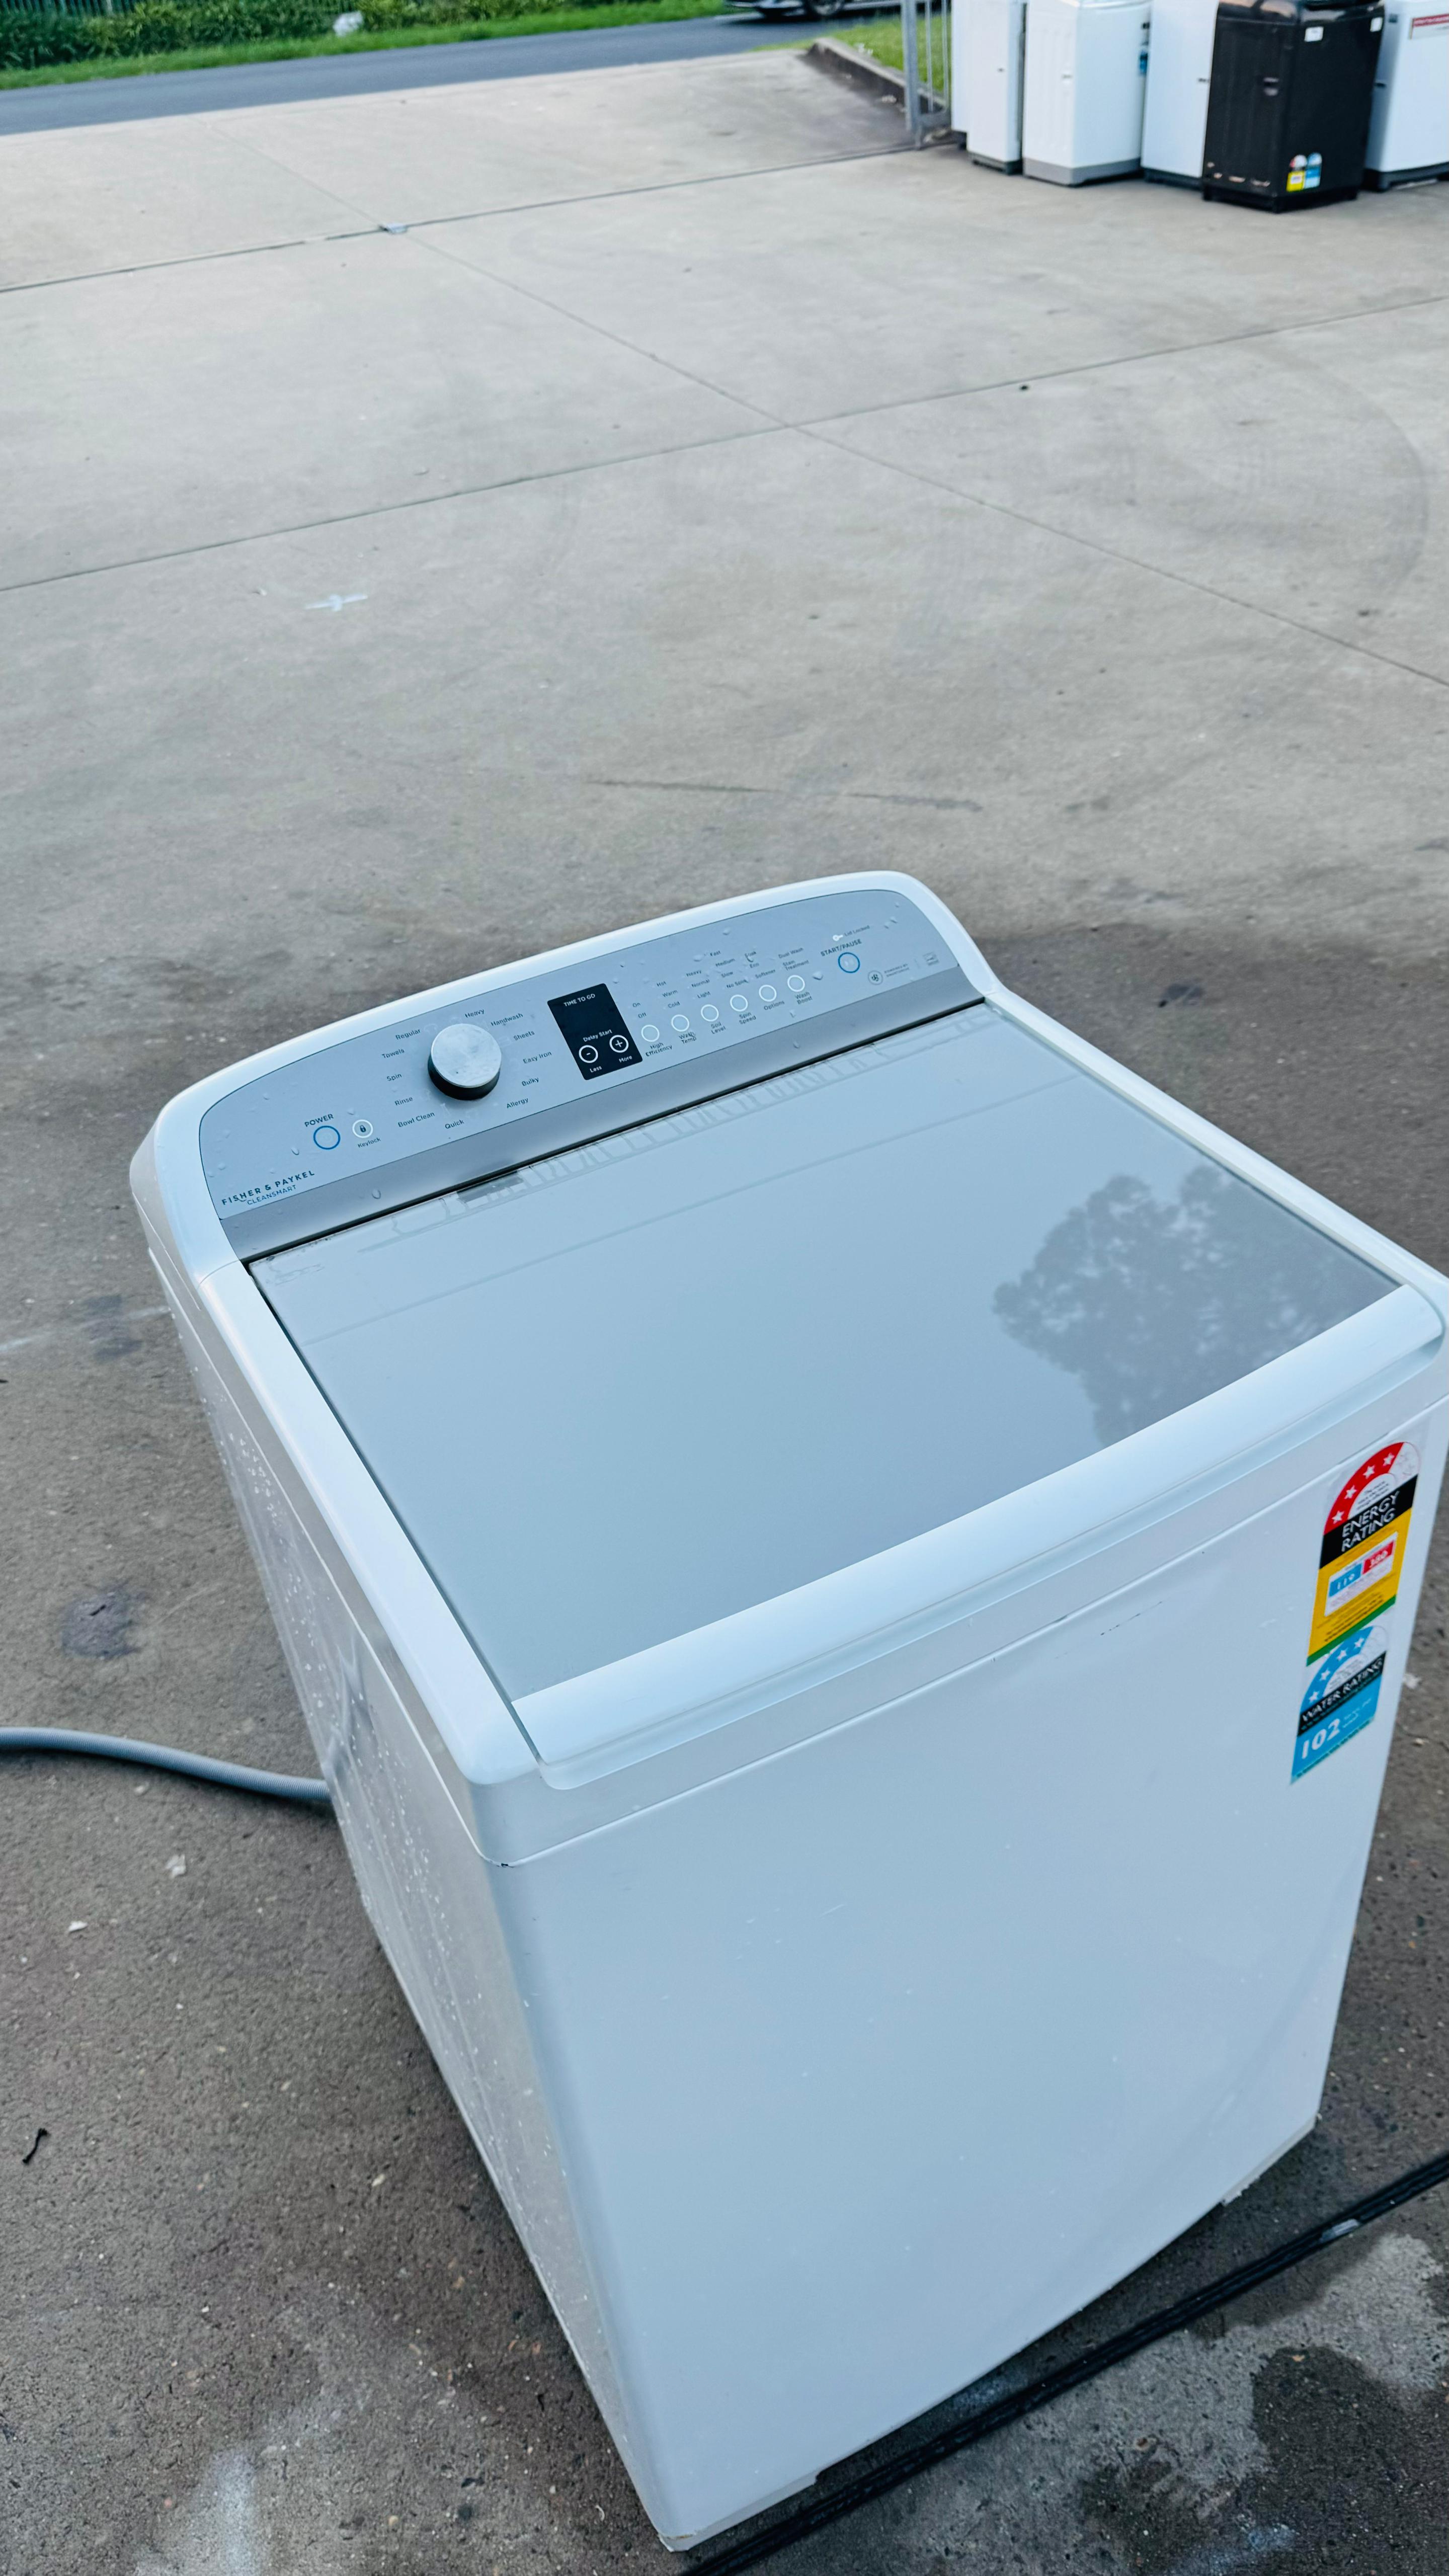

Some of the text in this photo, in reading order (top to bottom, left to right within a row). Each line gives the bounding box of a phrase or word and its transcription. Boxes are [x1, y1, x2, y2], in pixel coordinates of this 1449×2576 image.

[820, 939, 862, 957] START/PAUSE
[563, 998, 577, 1007] TIME
[586, 993, 596, 1001] GO
[662, 989, 678, 998] Warm
[697, 991, 711, 999] Light
[668, 1001, 680, 1009] Cold
[764, 1000, 785, 1011] Options
[464, 1008, 485, 1019] Heavy
[491, 1012, 523, 1027] Handwash
[395, 1028, 421, 1041] Regular
[513, 1030, 535, 1041] Sheets
[583, 1028, 612, 1042] Delay Start
[382, 1048, 405, 1059] Towels
[523, 1055, 538, 1065] Easy
[618, 1055, 632, 1063] More
[589, 1065, 602, 1074] Less
[386, 1073, 402, 1083] Spin
[521, 1076, 539, 1087] Bulky
[394, 1096, 414, 1107] Rinse
[506, 1097, 529, 1110] Allergy
[304, 1113, 334, 1128] POWER
[397, 1111, 435, 1128] Bowl Clean
[444, 1118, 464, 1131] Quick
[358, 1137, 381, 1149] Keylock
[221, 1187, 261, 1205] FISHER
[275, 1170, 315, 1187] PAYKEL
[247, 1184, 296, 1205] CLEANSMART
[1342, 1490, 1400, 1538] ENERGY
[1341, 1507, 1396, 1552] RATING
[1302, 1690, 1341, 1722] WATER
[1302, 1718, 1340, 1759] 102
